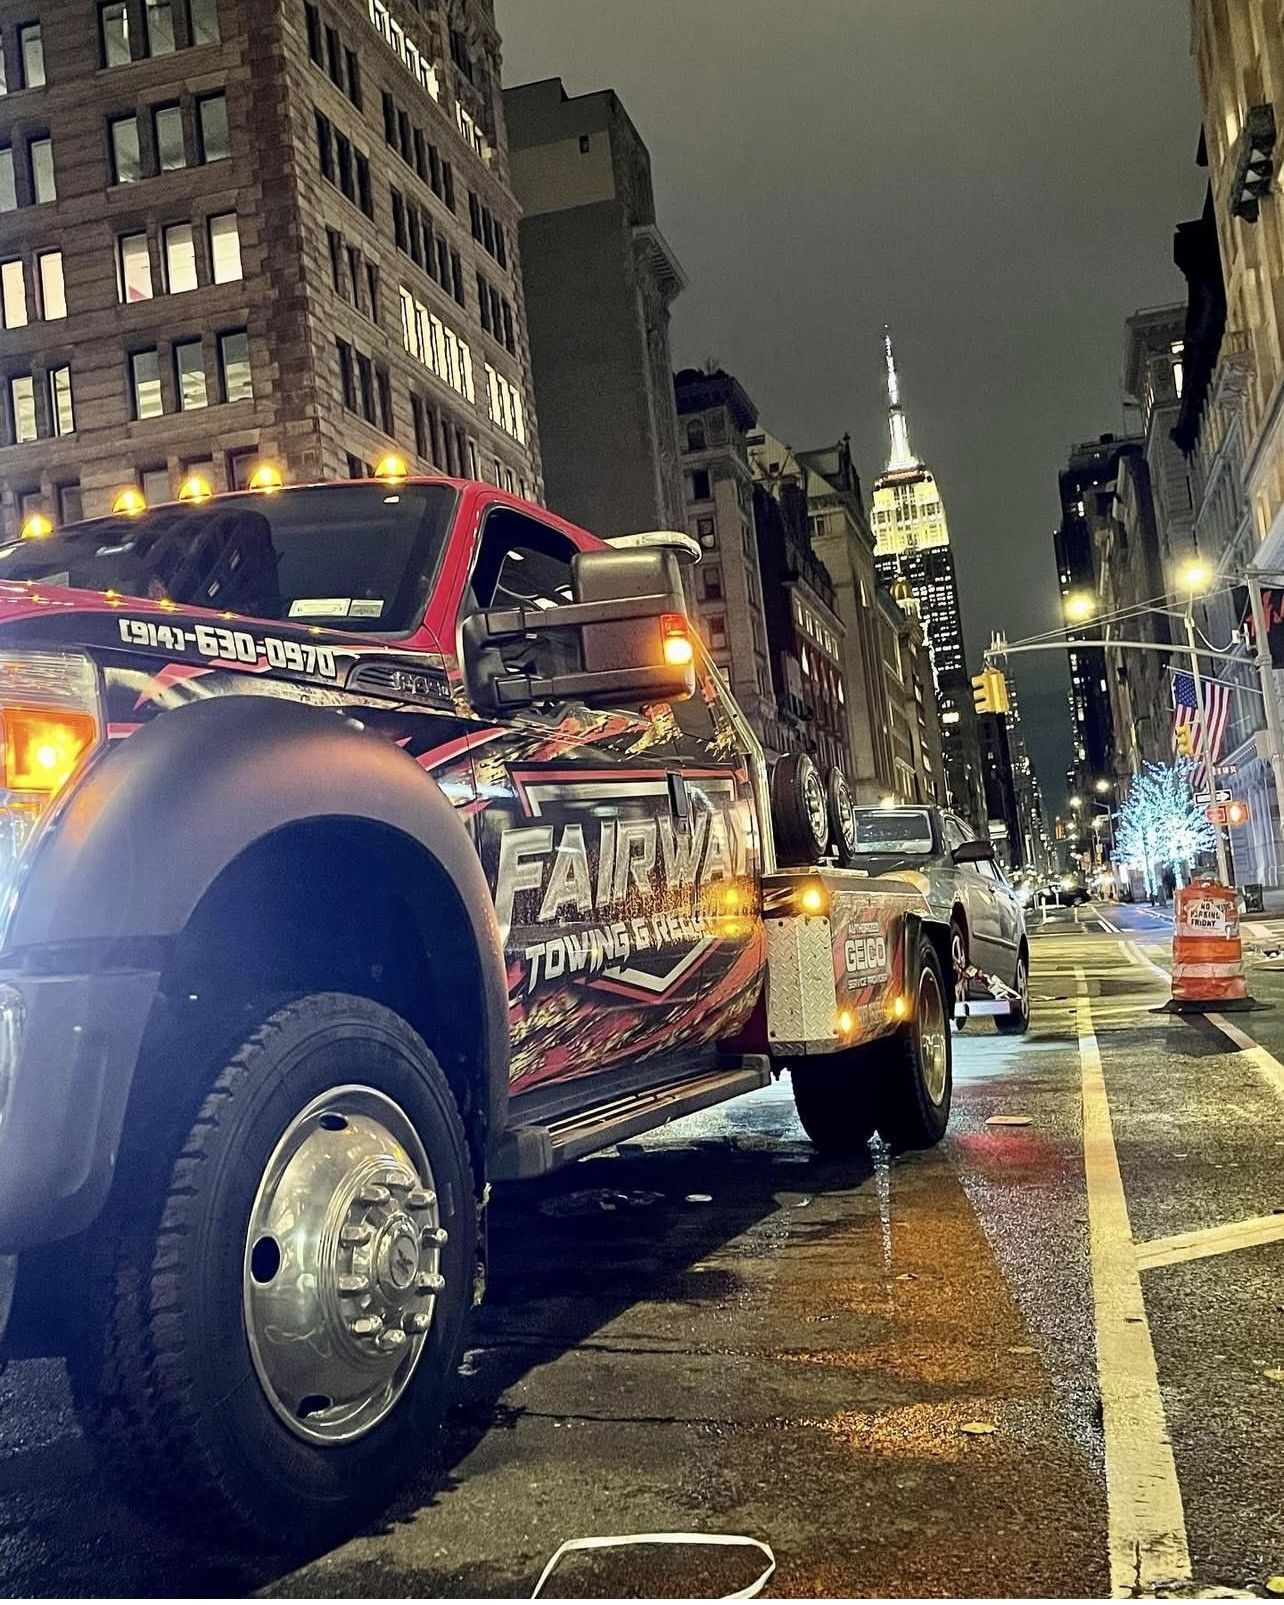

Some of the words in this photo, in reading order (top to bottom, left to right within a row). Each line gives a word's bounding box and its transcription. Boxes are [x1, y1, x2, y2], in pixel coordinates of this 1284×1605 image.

[1200, 902, 1211, 910] NO
[1191, 918, 1217, 927] FRIDAY
[525, 920, 631, 994] TOWING
[844, 936, 887, 972] GEICO
